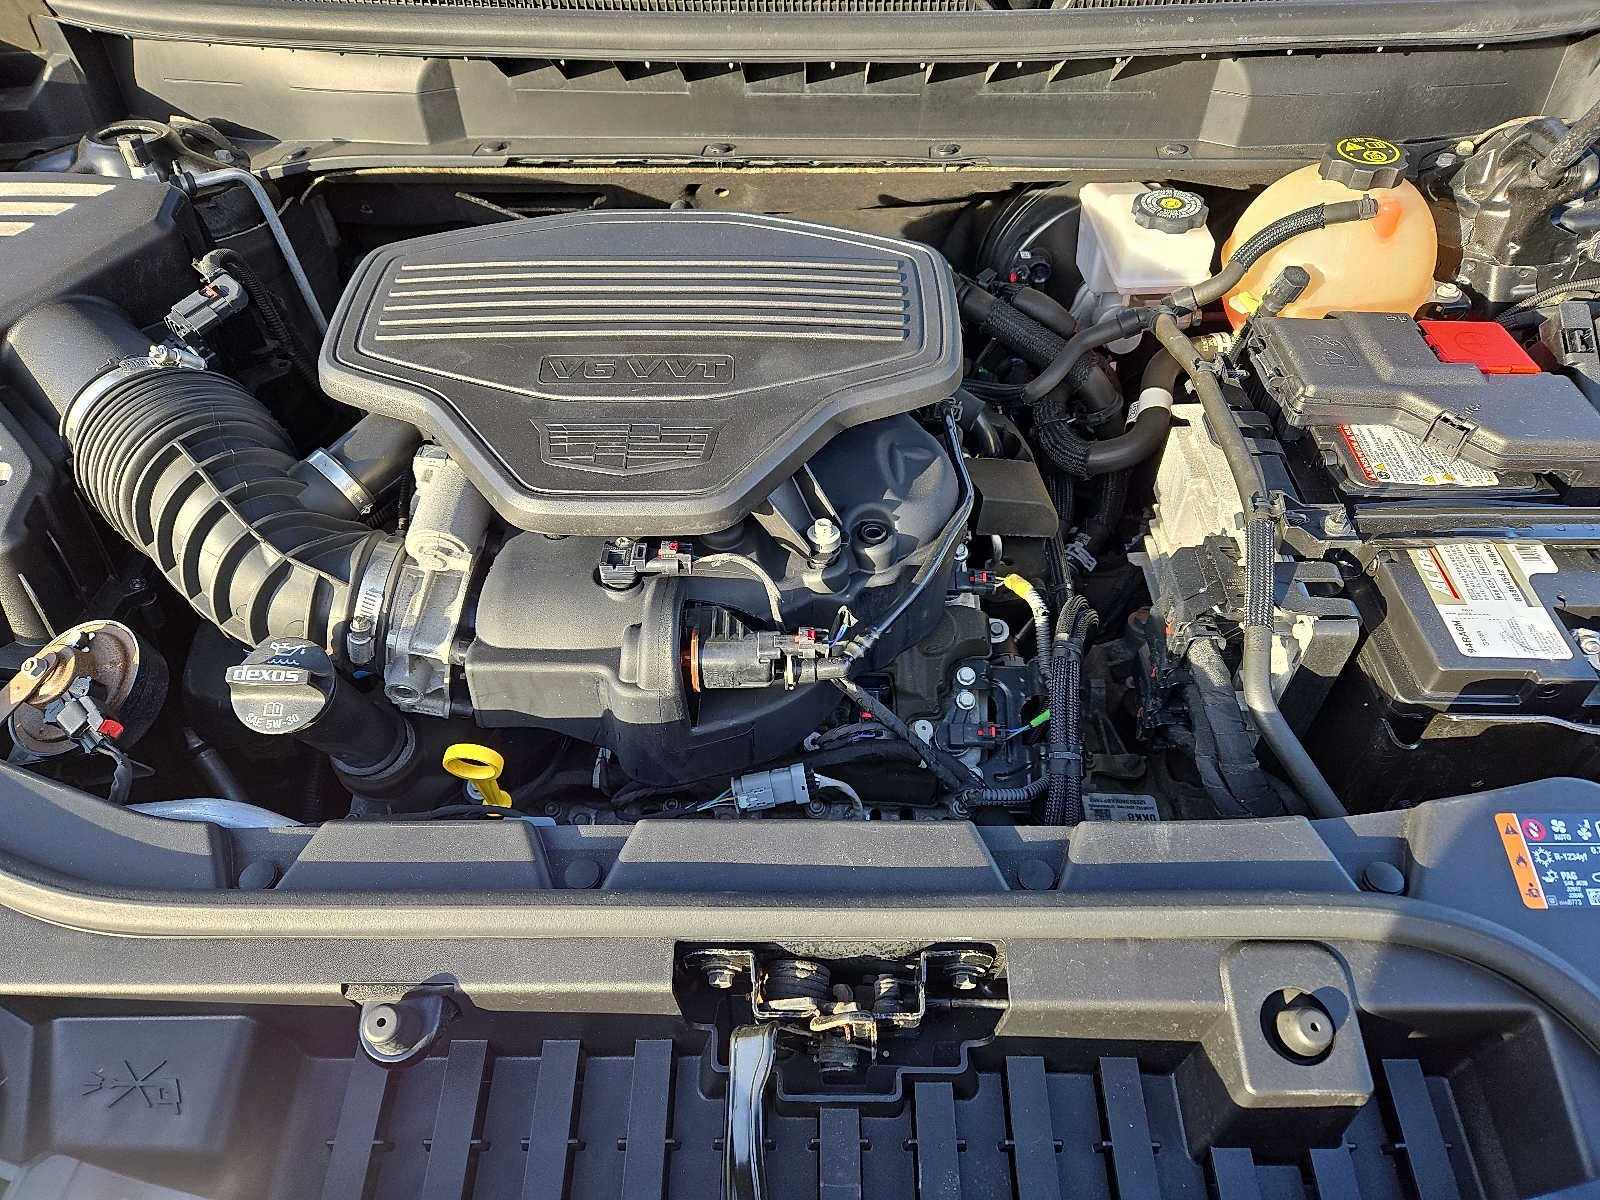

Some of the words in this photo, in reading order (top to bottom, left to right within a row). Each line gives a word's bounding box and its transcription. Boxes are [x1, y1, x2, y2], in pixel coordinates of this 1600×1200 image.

[548, 359, 616, 380] V6
[626, 358, 728, 379] VVT
[232, 665, 301, 682] dexos
[246, 712, 262, 728] SAE
[265, 713, 300, 729] 5W-30
